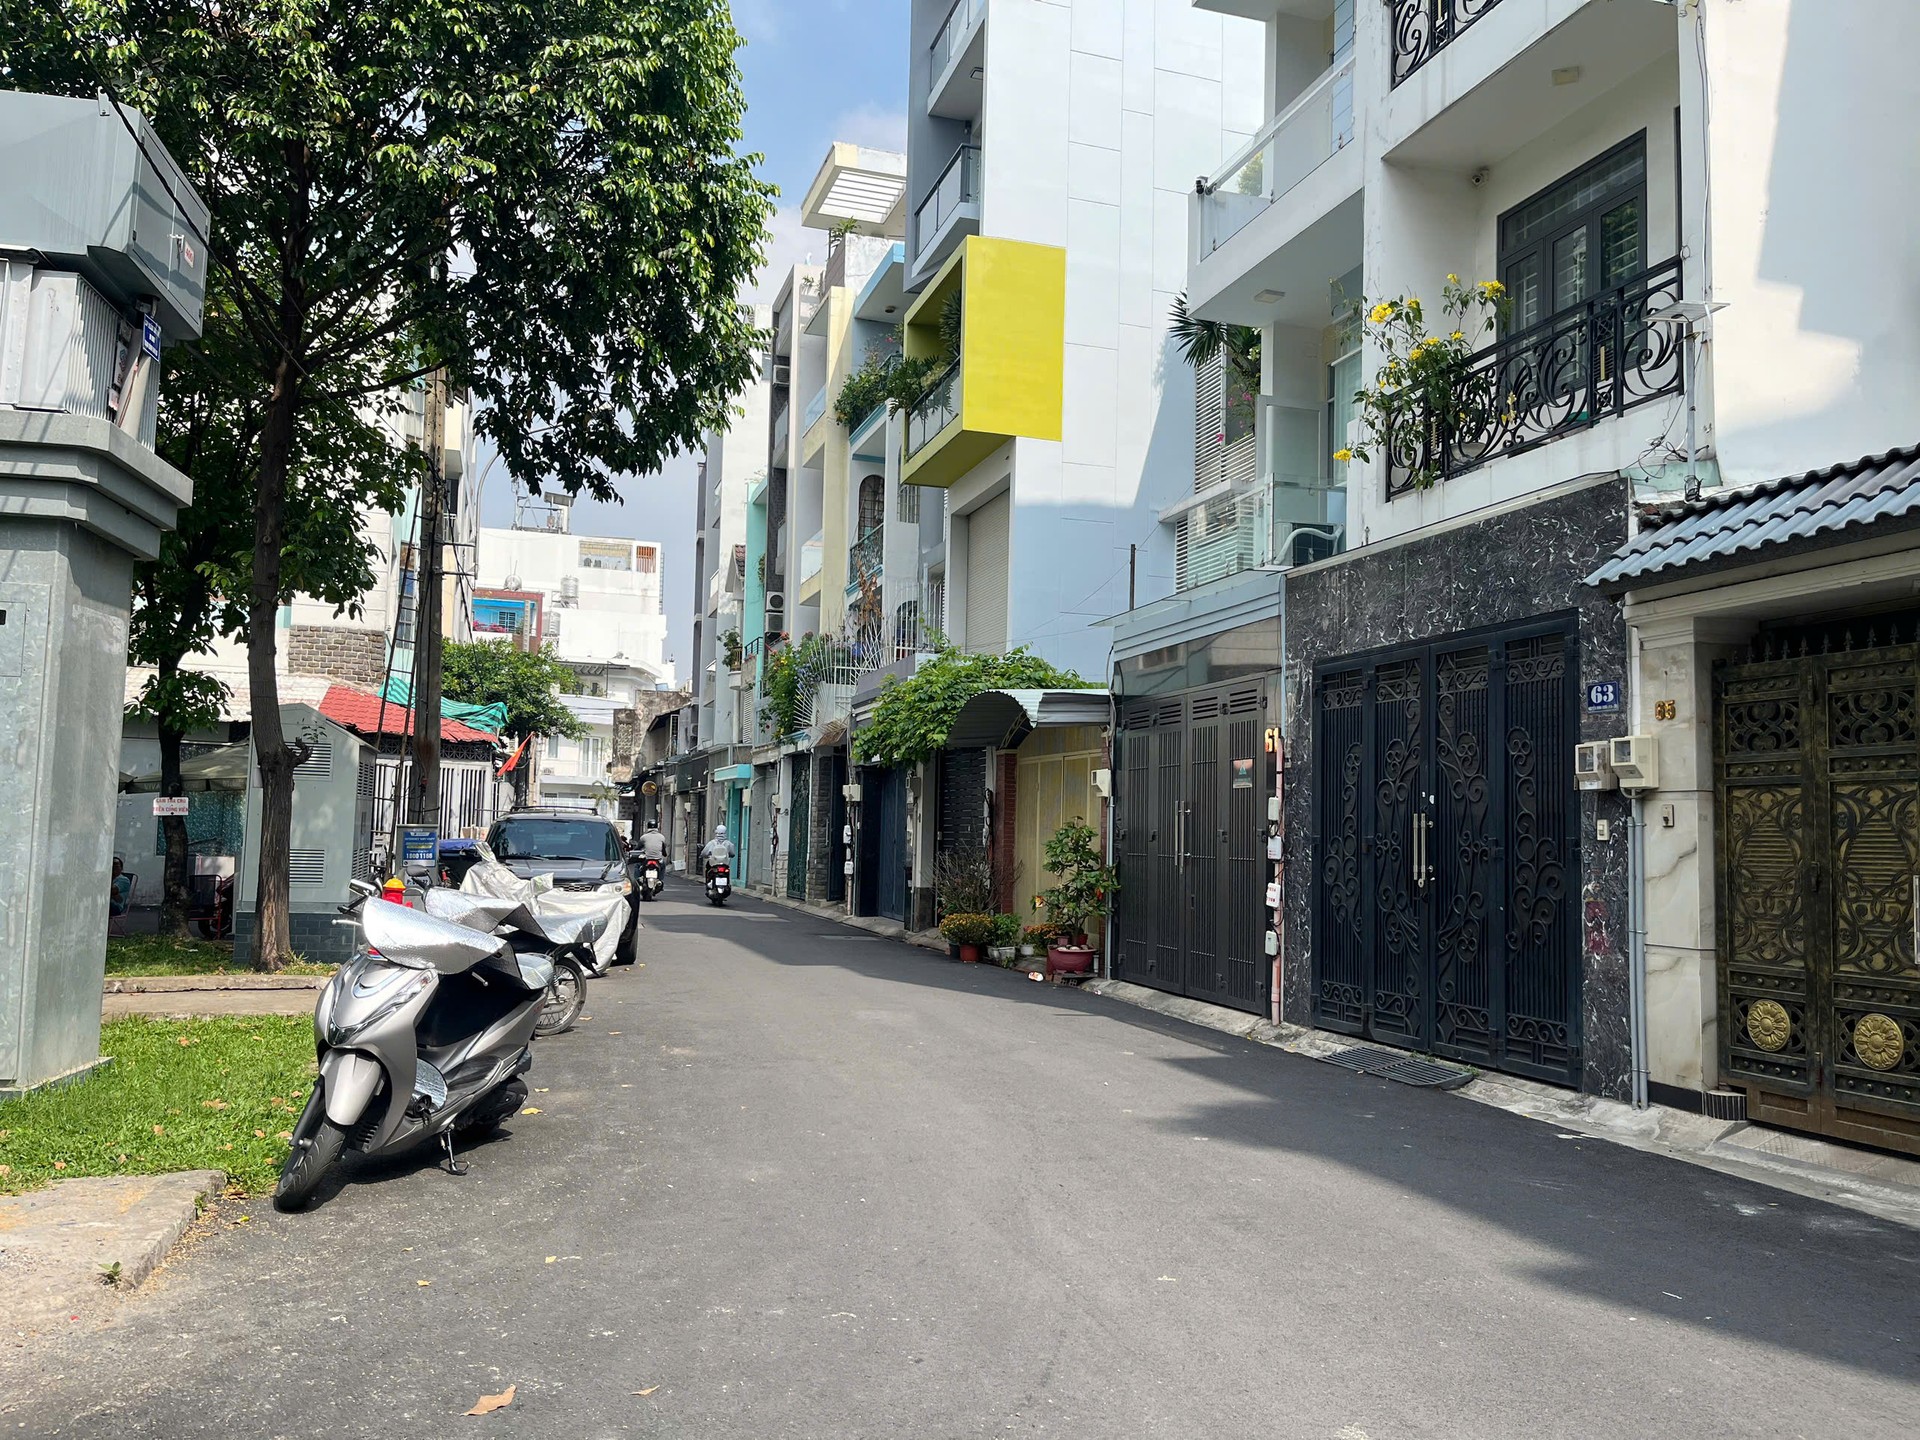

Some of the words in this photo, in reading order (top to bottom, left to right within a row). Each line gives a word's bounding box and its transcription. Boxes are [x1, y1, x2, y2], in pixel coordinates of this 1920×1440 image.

[1591, 684, 1614, 704] 63
[1655, 700, 1676, 721] 65
[1264, 727, 1280, 753] 61
